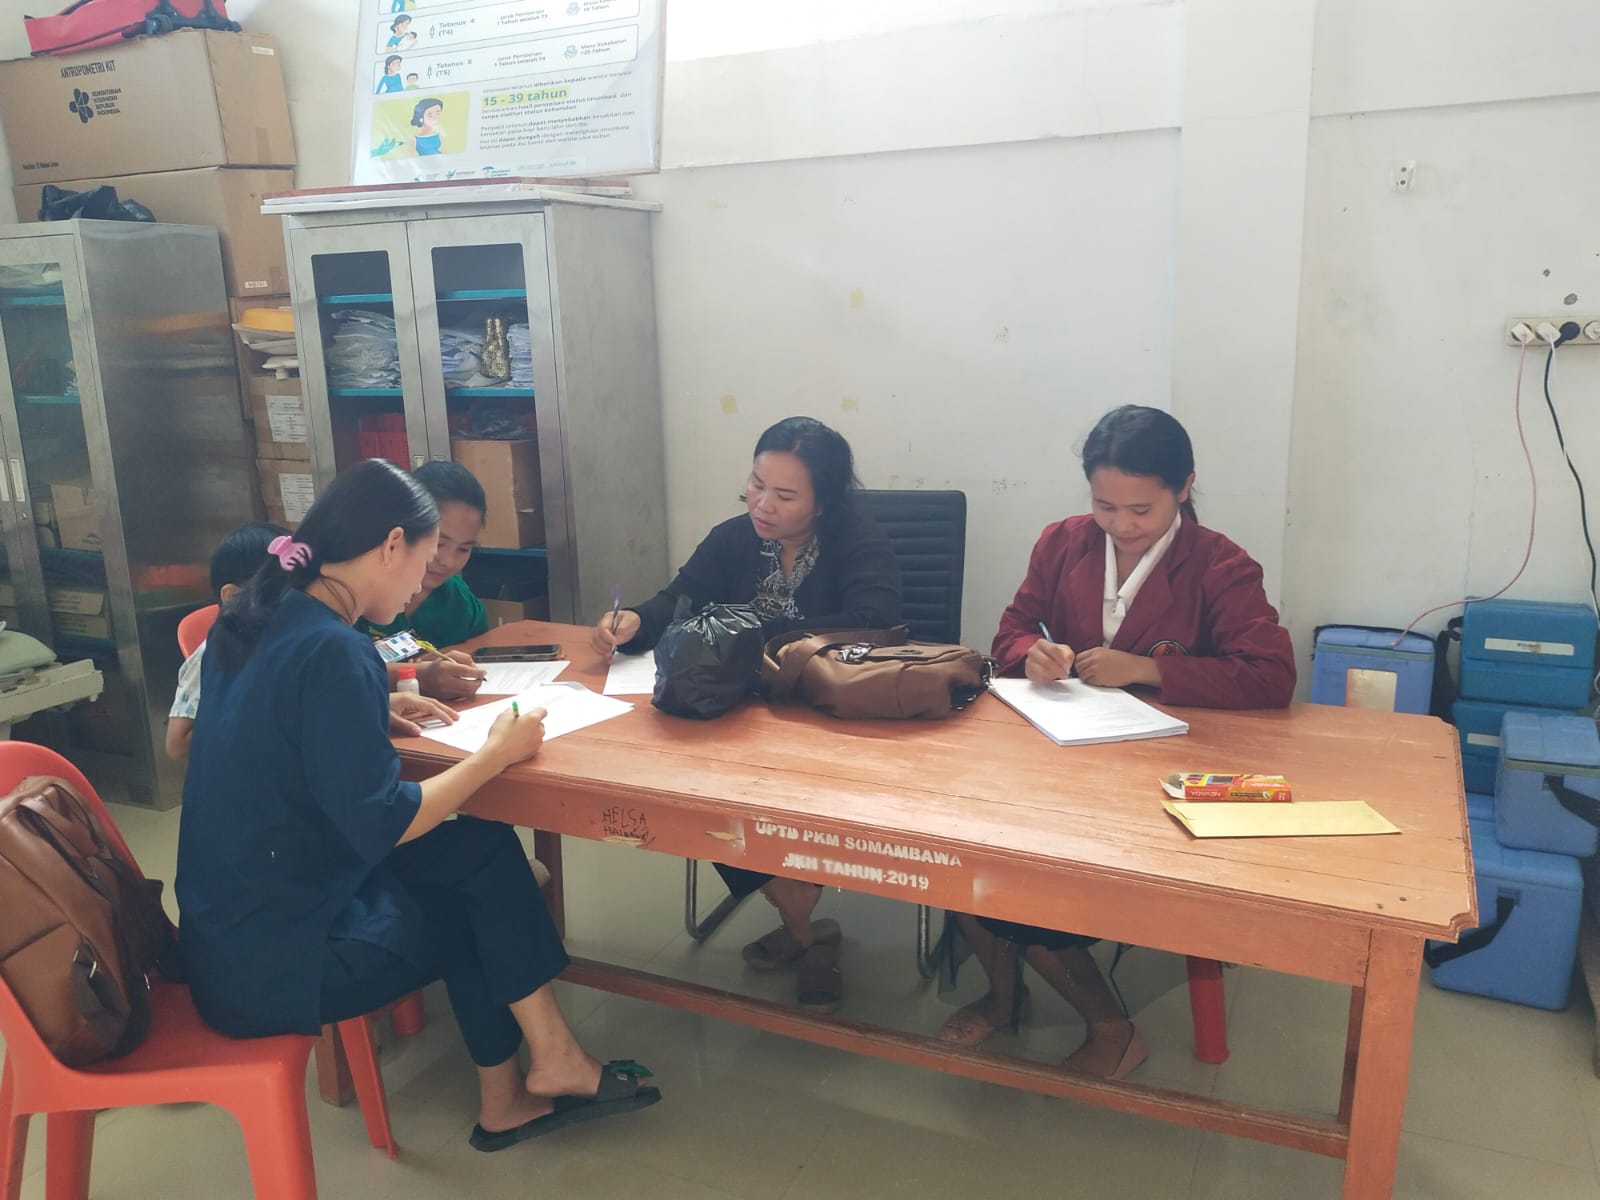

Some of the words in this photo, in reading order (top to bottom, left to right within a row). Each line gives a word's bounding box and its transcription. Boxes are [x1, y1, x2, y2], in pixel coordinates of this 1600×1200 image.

[440, 20, 466, 29] Tetanus
[61, 62, 105, 78] ANTROPOMETRI
[104, 60, 116, 72] KIT
[437, 60, 464, 70] Tetanus
[483, 96, 497, 106] 15
[508, 92, 523, 104] 39
[527, 89, 567, 101] tahun
[602, 806, 647, 829] HELSA
[755, 821, 799, 840] UPTD
[803, 829, 840, 847] PKM
[844, 836, 962, 867] SOMAMBAWA
[821, 858, 883, 882] TAHUN
[886, 869, 929, 891] 2019
